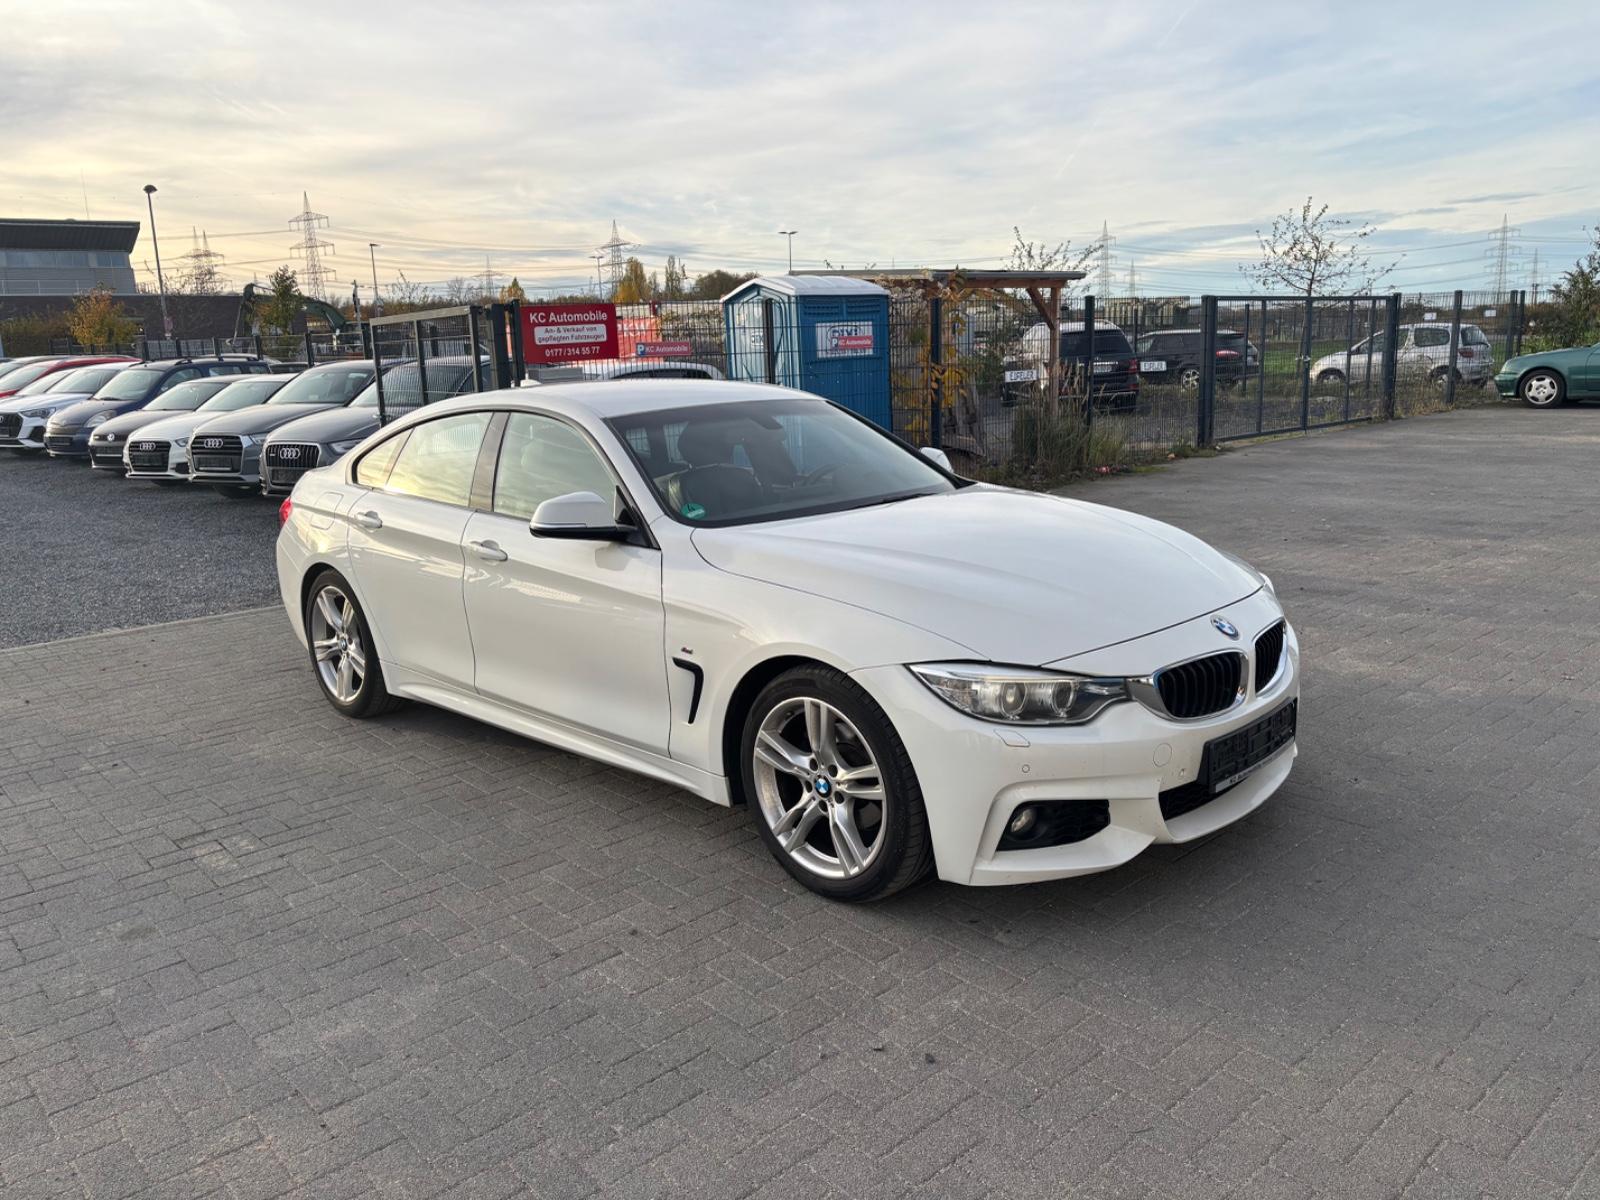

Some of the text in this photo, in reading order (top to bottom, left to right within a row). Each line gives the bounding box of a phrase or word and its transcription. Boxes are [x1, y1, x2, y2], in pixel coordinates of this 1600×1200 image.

[529, 310, 608, 324] KC Automobile
[538, 333, 605, 343] gepflegten Fahrzeugen
[645, 345, 655, 353] KC
[656, 344, 688, 353] Automobile
